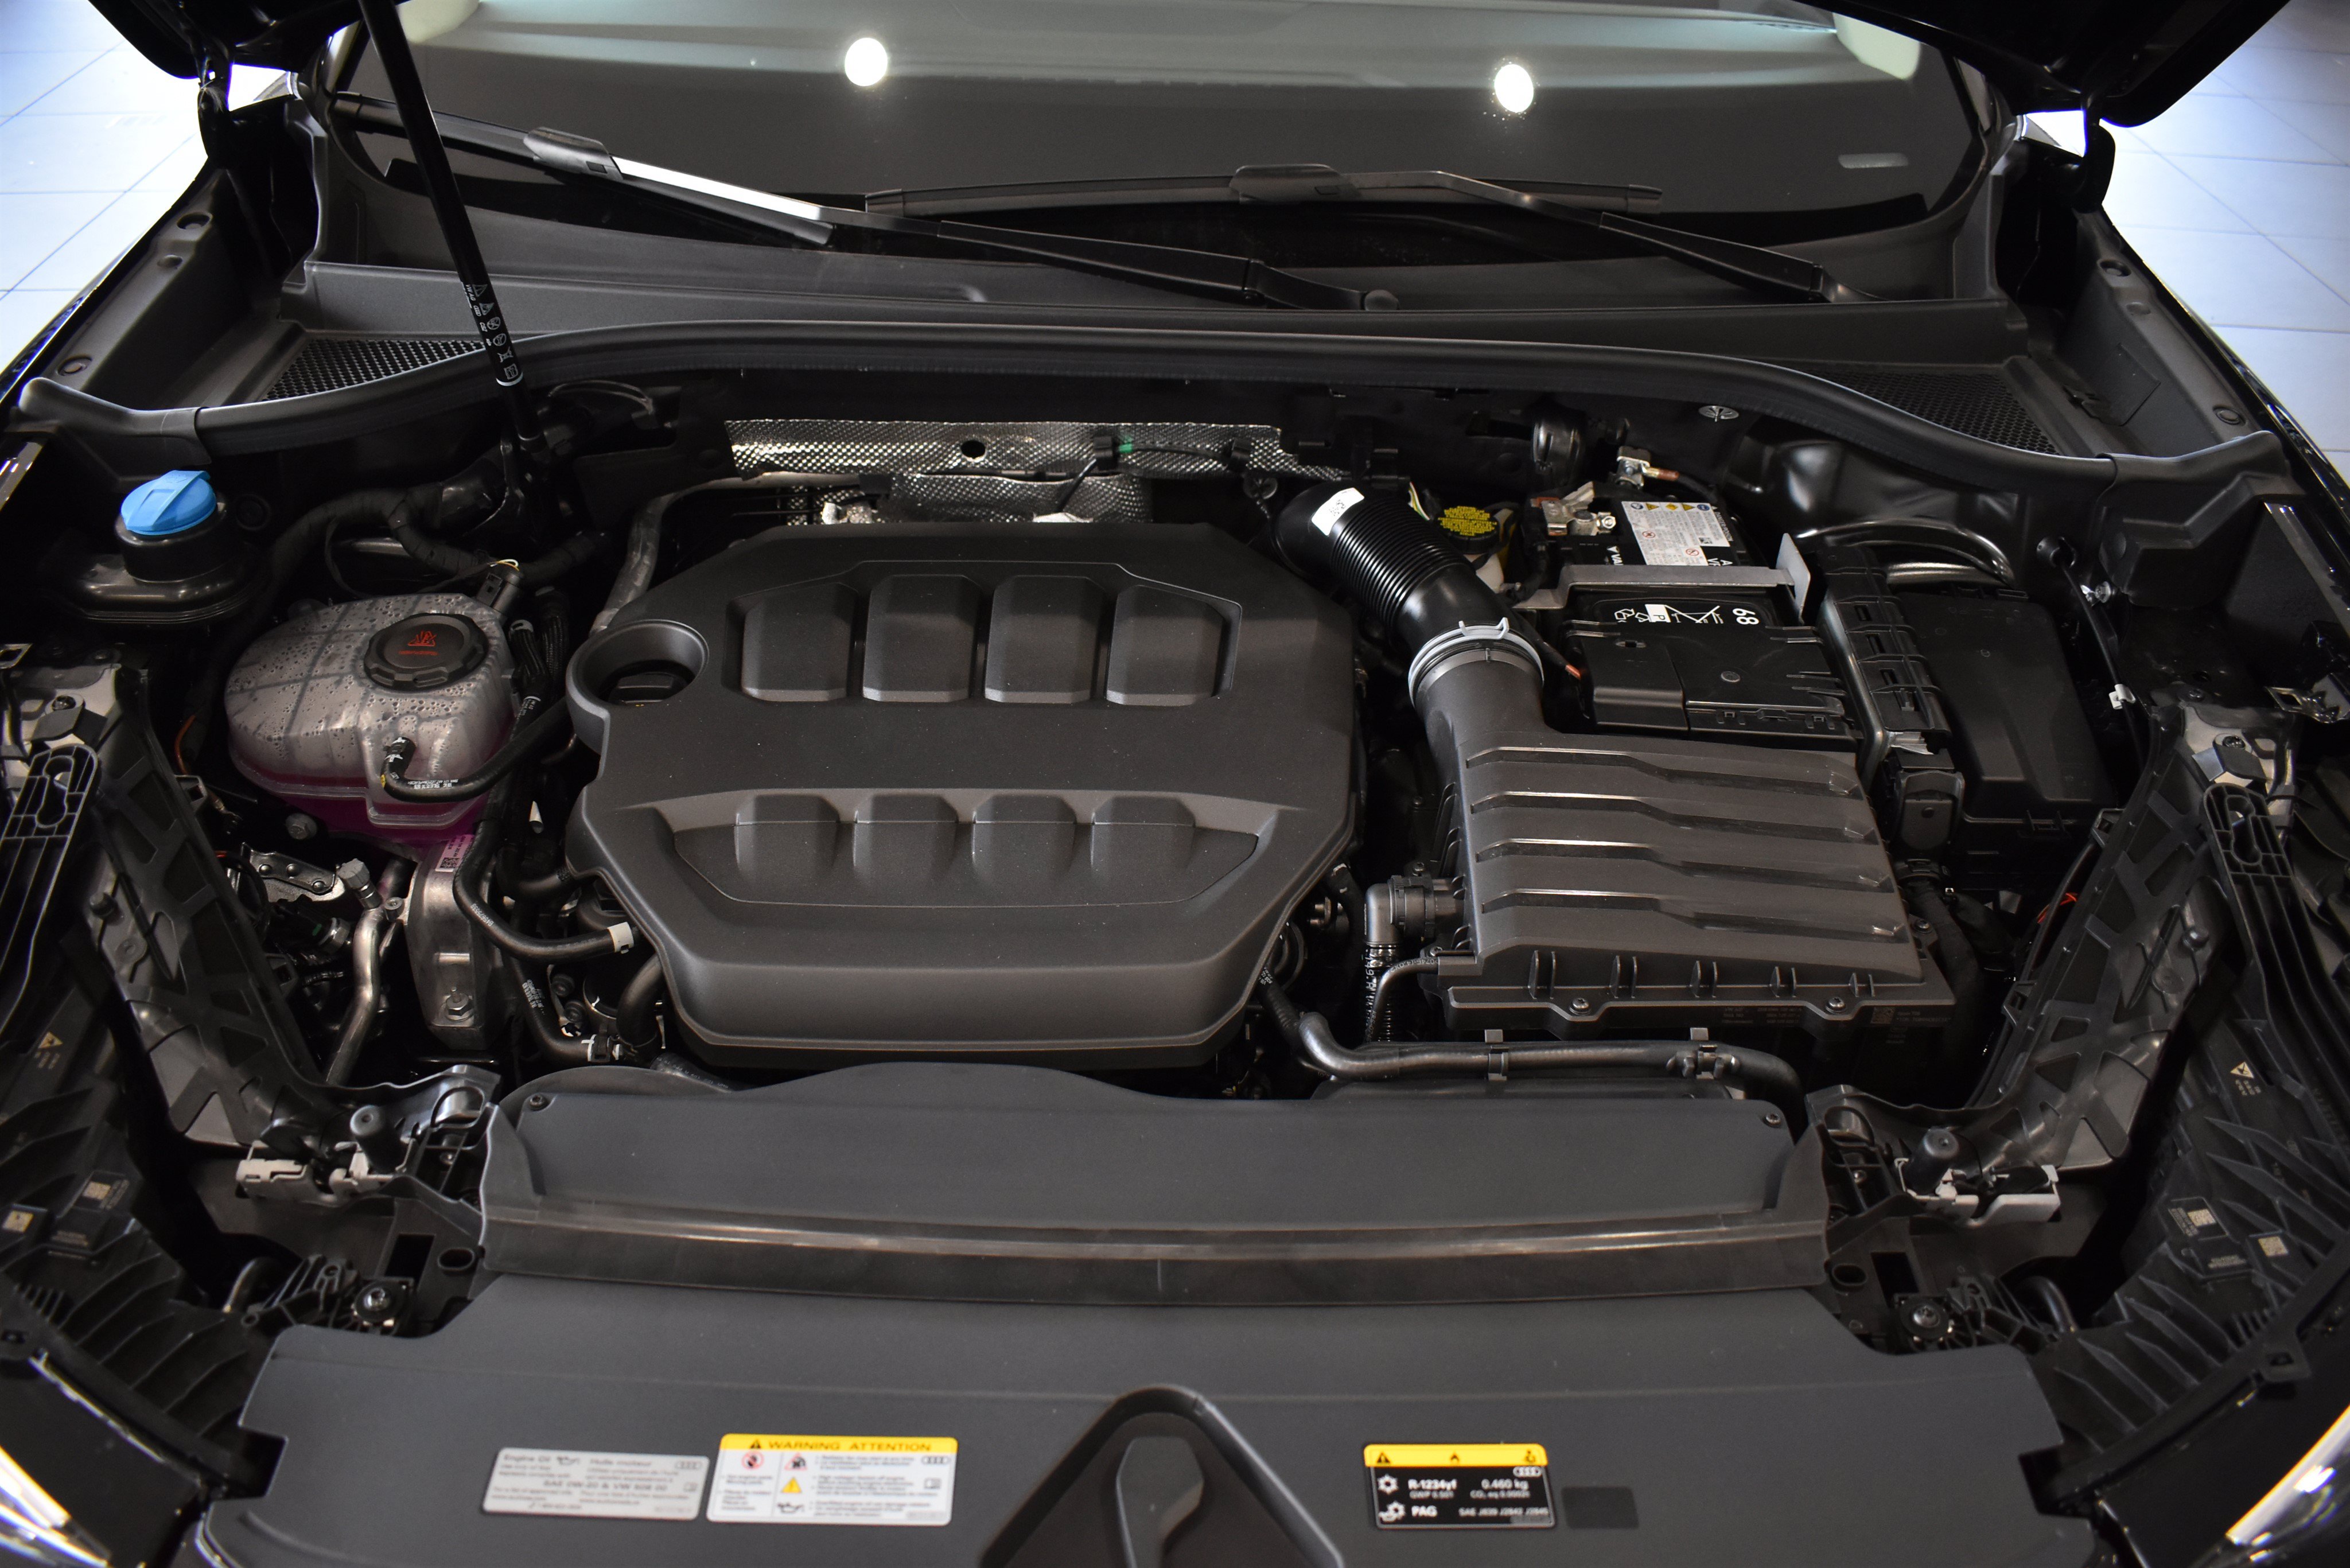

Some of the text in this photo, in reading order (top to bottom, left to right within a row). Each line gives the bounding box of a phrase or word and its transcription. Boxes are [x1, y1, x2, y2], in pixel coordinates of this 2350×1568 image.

[769, 1441, 931, 1452] WARNING ATTENTION
[1514, 1478, 1529, 1491] kg
[1411, 1505, 1438, 1518] PAG
